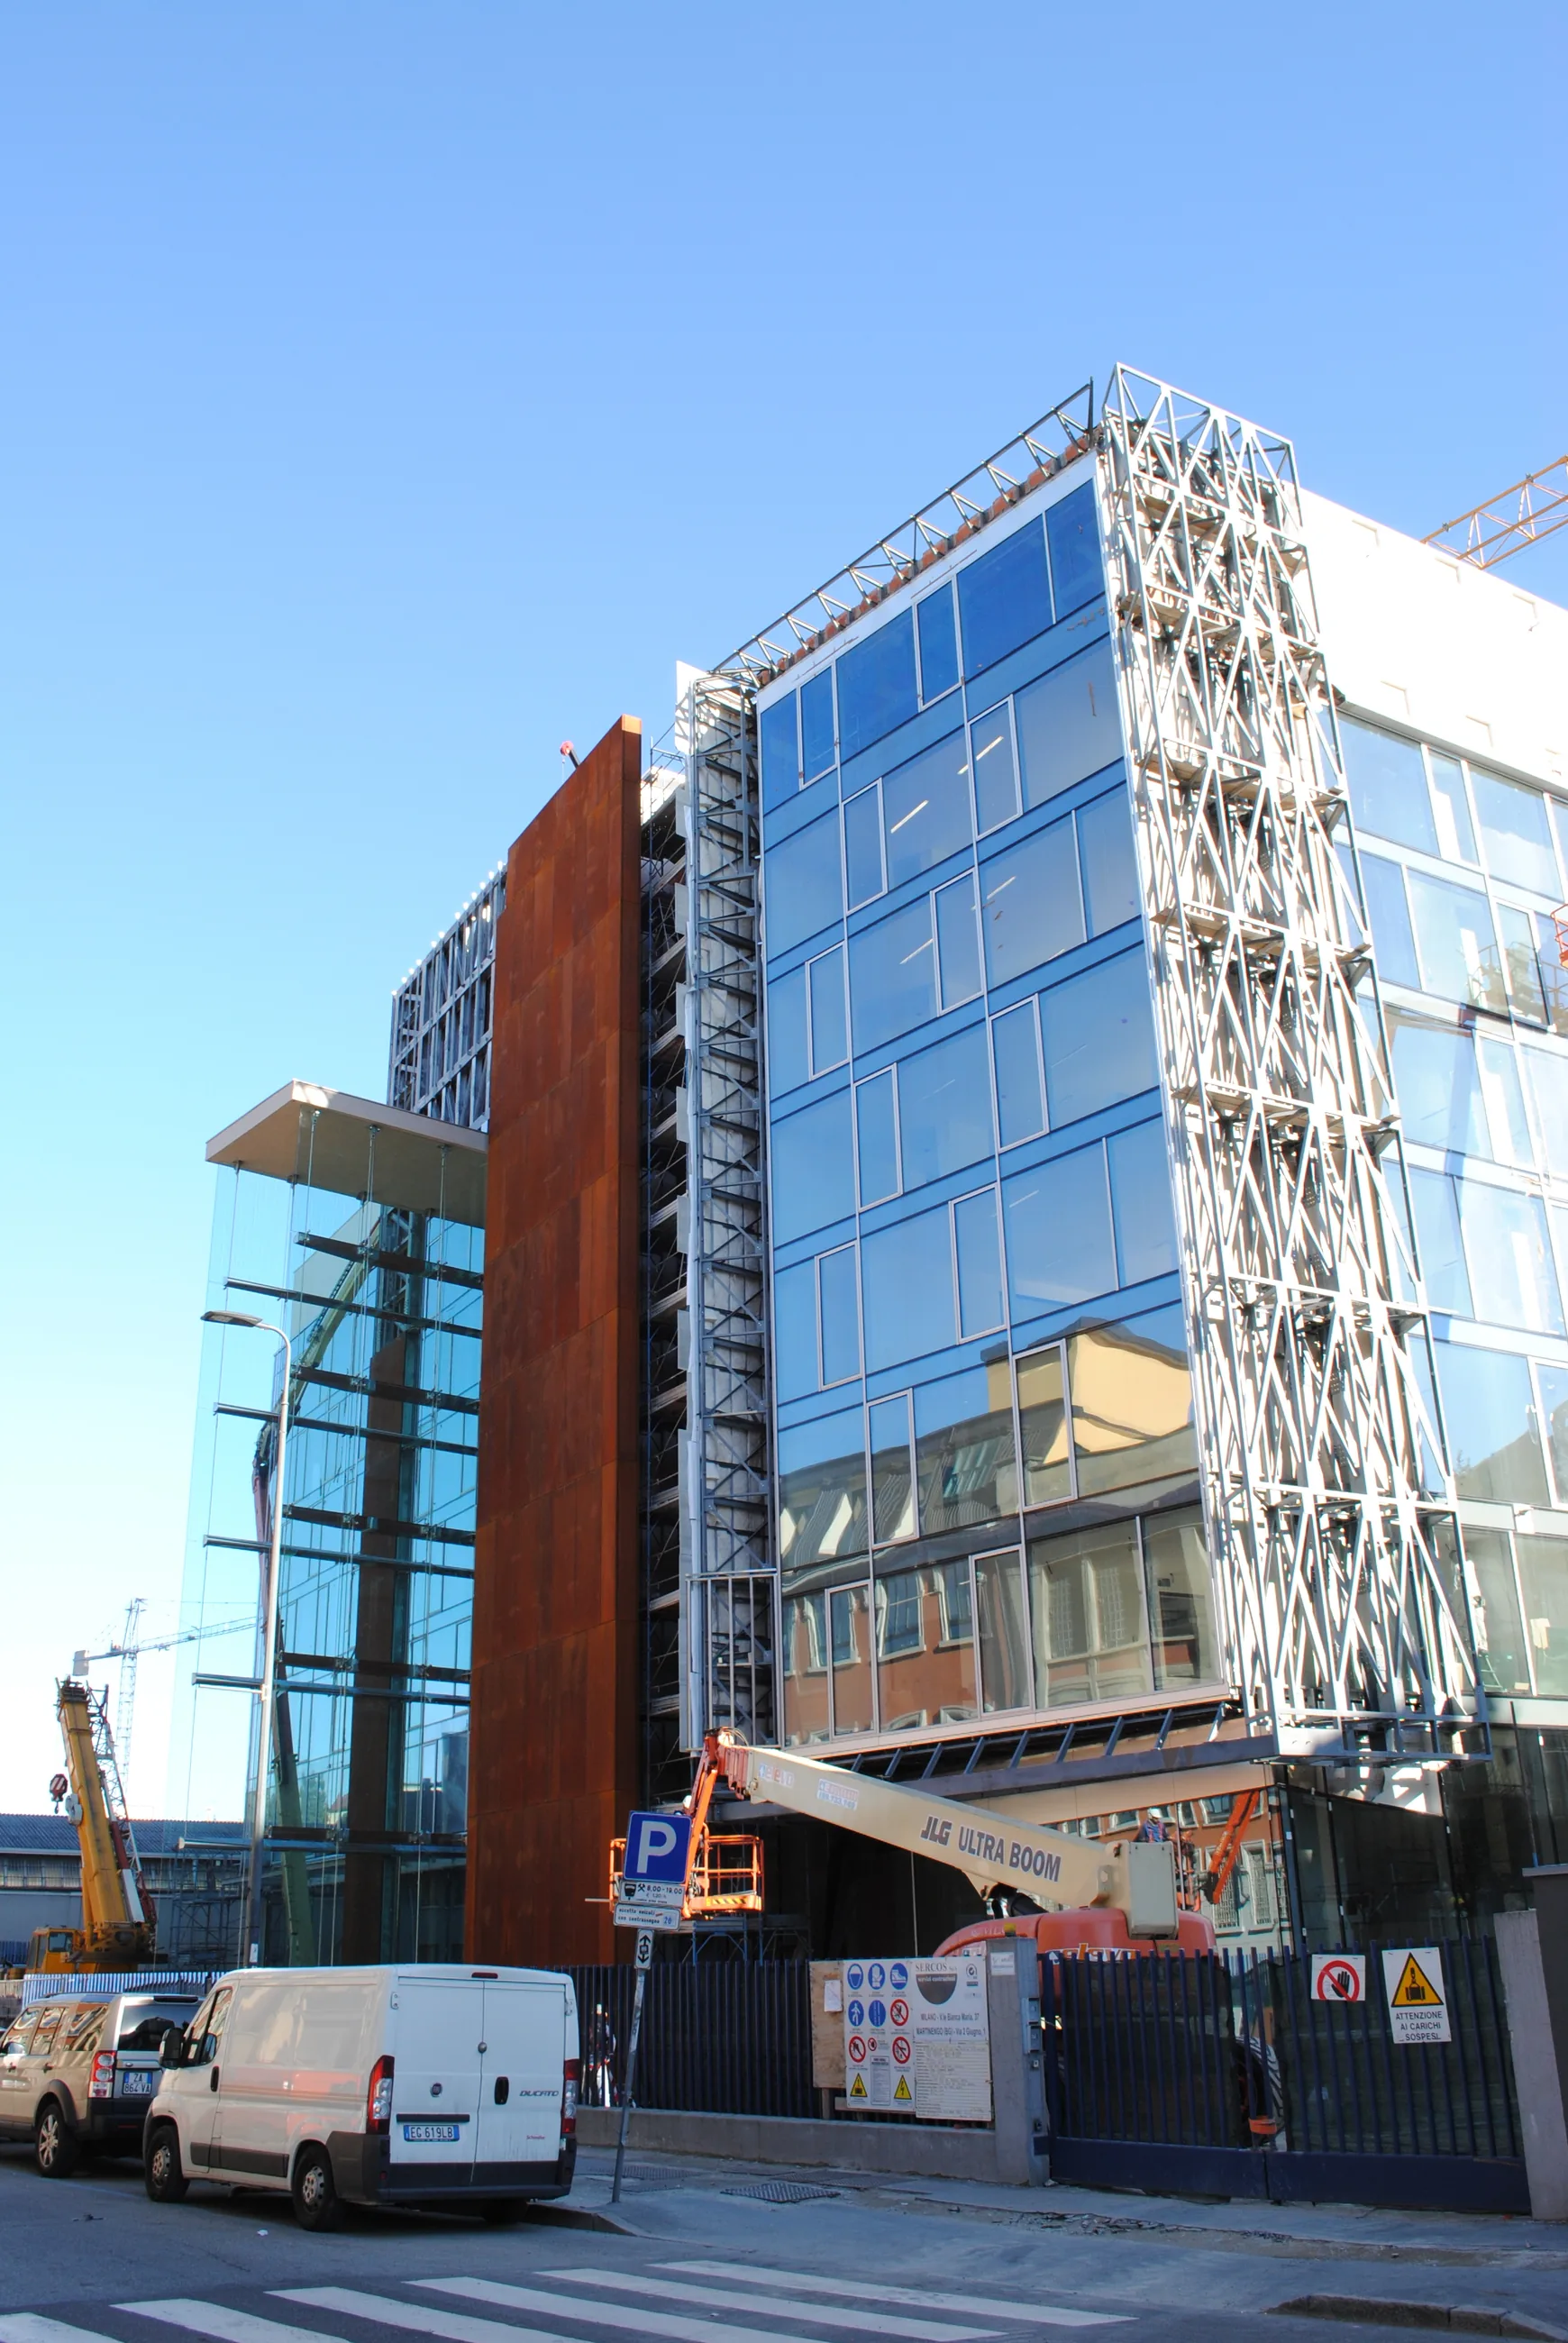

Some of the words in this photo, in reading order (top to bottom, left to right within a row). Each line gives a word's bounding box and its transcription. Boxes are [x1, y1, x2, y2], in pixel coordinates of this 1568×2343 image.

[636, 1820, 677, 1873] P
[920, 1816, 953, 1846] JLG
[958, 1826, 1005, 1864] ULTRA
[1008, 1841, 1062, 1883] BOOM
[915, 1963, 948, 1972] SERCOS
[920, 2012, 936, 2021] MILANO
[1396, 2010, 1443, 2020] ATTENZIONE
[1400, 2022, 1408, 2030] AI
[1409, 2021, 1441, 2030] CARICHI
[133, 2073, 142, 2083] ZA
[124, 2083, 139, 2092] 864
[141, 2083, 150, 2092] VA
[410, 2127, 422, 2138] EG
[424, 2127, 453, 2138] 619LB
